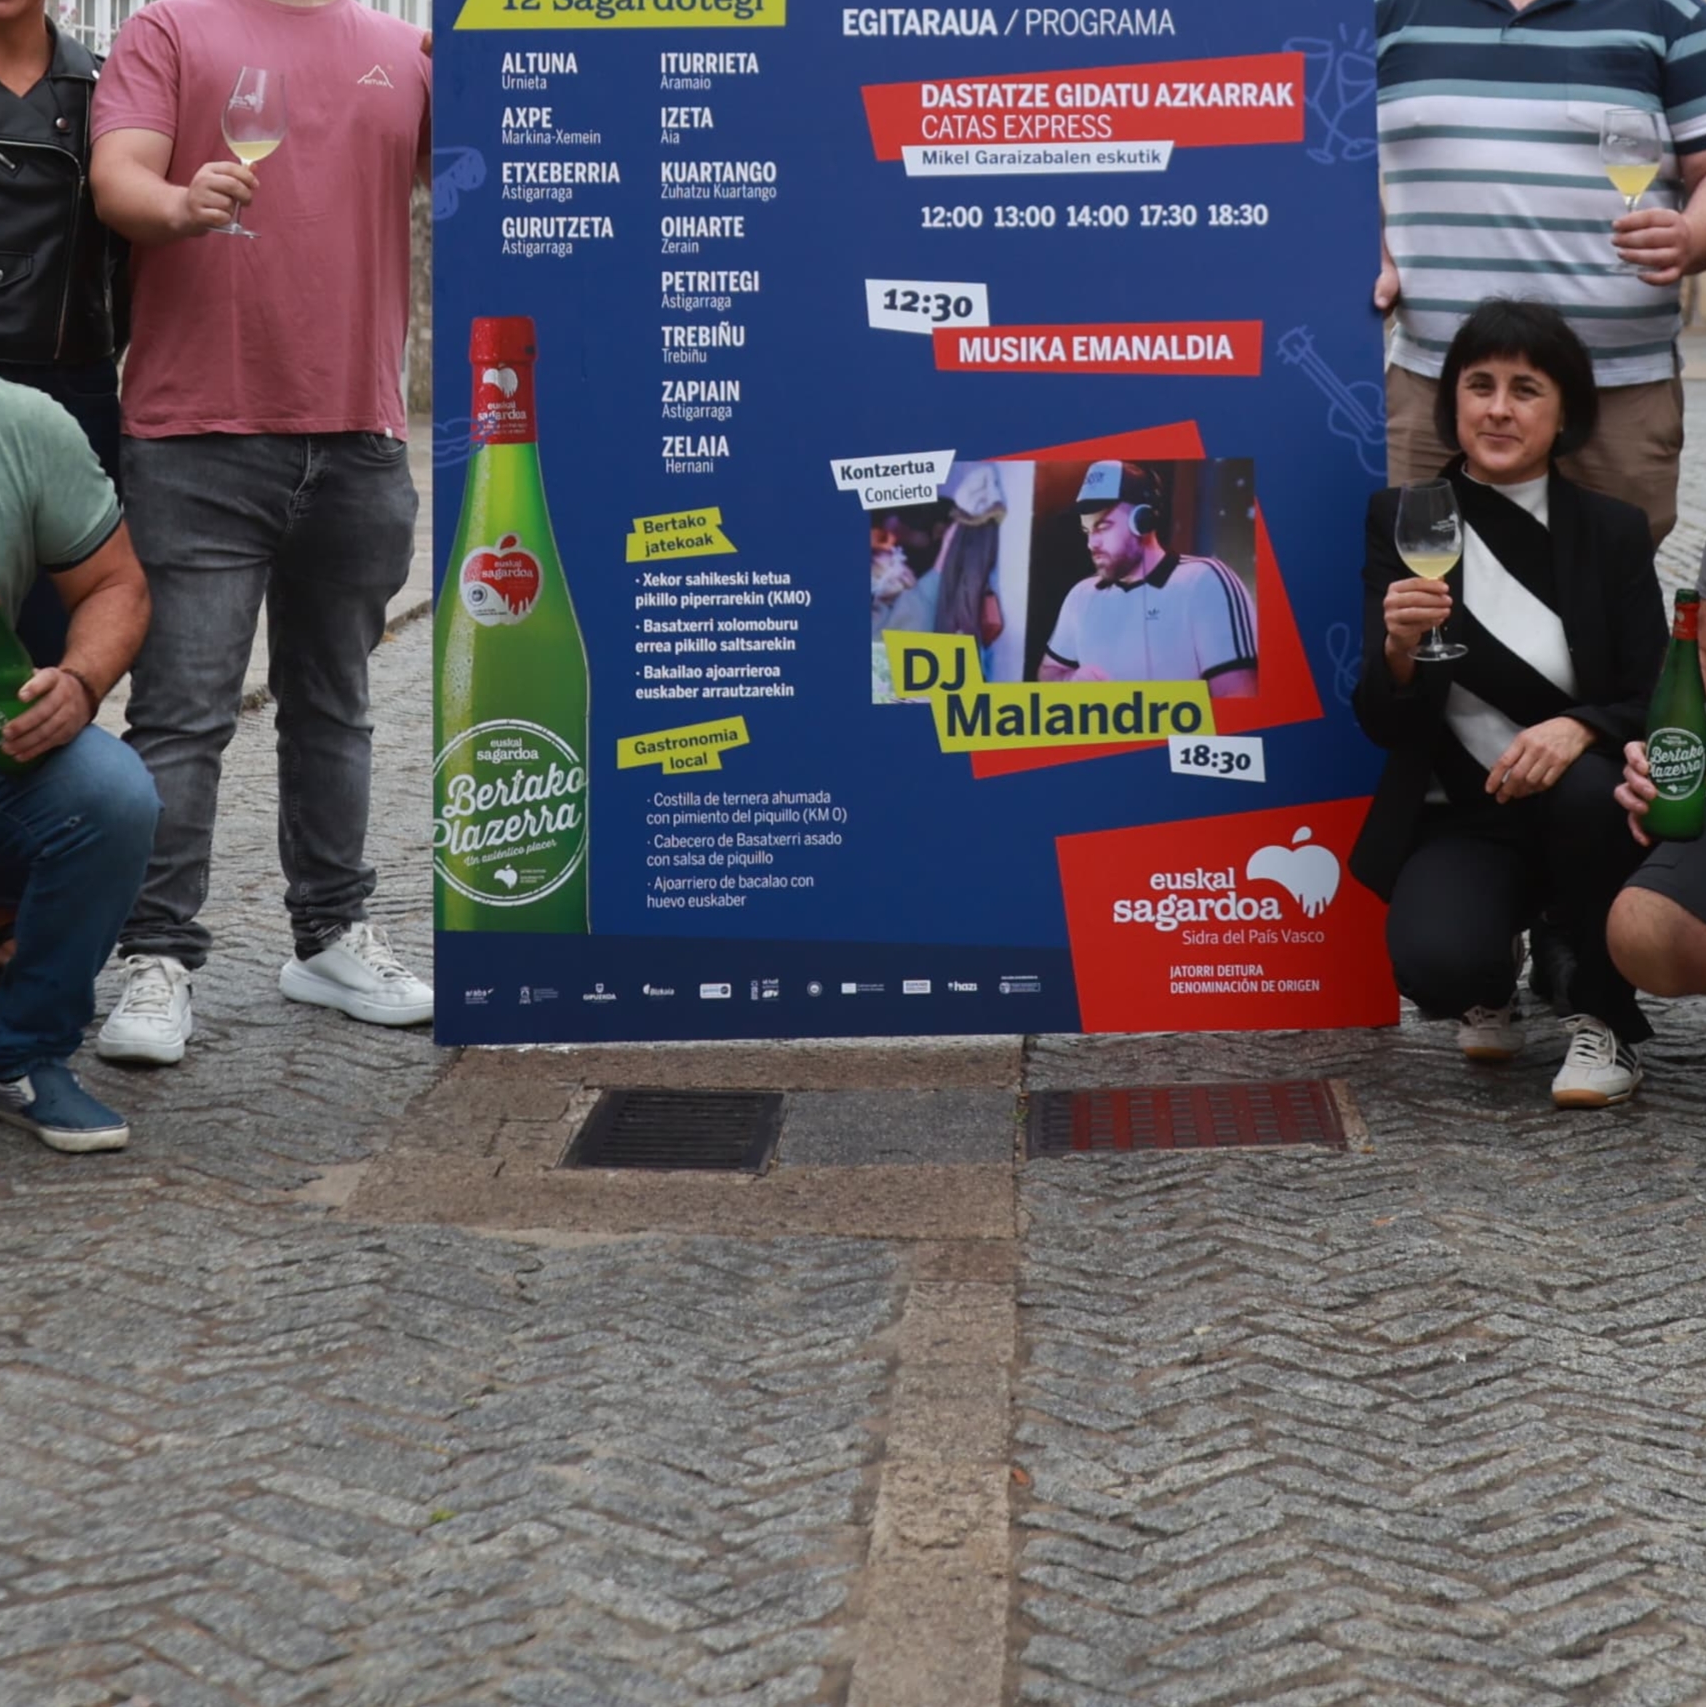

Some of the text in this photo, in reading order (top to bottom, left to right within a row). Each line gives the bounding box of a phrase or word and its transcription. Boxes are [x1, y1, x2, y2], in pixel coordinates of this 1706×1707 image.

[842, 8, 1176, 36] EGITARAUA / PROGRAMA
[501, 52, 578, 74] ALTUNA
[660, 52, 759, 74] ITURRIETA
[501, 74, 547, 90] Urnieta
[660, 75, 711, 90] Aramaio
[921, 81, 1294, 109] DASTATZE GIDATU AZKARRAK
[501, 106, 553, 128] AXPE
[660, 106, 714, 128] IZETA
[921, 113, 1113, 140] CATAS EXPRESS
[501, 129, 601, 145] Markina-Xemein
[660, 129, 680, 144] Aia
[921, 148, 1161, 166] Mikel Garaizabalen eskutik
[501, 161, 621, 183] ETXEBERRIA
[660, 161, 777, 183] KUARTANGO
[501, 184, 573, 203] Astigarraga
[660, 183, 777, 202] Zuhatzu Kuartango
[921, 203, 1269, 229] 12:00 13:00 14:00 17:30 18:30
[501, 216, 614, 239] GURUTZETA
[660, 216, 745, 238] OIHARTE
[501, 239, 573, 258] Astigarraga
[660, 238, 699, 254] Zerain
[661, 270, 760, 292] PETRITEGI
[661, 293, 732, 311] Astigarraga
[882, 288, 974, 323] 12:30
[661, 320, 746, 347] TREBIÑU
[661, 347, 707, 364] Trebiñu
[958, 333, 1234, 364] MUSIKA EMANALDIA
[661, 380, 741, 403] ZAPIAIN
[662, 402, 733, 422] Astigarraga
[662, 435, 730, 458] ZELAIA
[665, 458, 714, 474] Hernani
[840, 457, 936, 482] Kontzertua
[864, 483, 933, 504] Concierto
[642, 514, 707, 535] Bertako
[645, 532, 714, 558] jatekoak
[481, 566, 534, 581] sagardoa
[642, 571, 791, 587] Xekor sahikeski ketua
[635, 592, 678, 610] pikillo
[680, 591, 765, 609] piperrarekin
[643, 617, 799, 633] Basatxerri xolomoburu
[635, 637, 796, 655] errea pikillo saltsarekin
[643, 663, 781, 681] Bakailao ajoarrieroa
[902, 647, 966, 692] DJ
[635, 683, 795, 700] euskaber arrautzarekin
[946, 691, 1203, 737] Malandro
[489, 737, 523, 748] euskal
[634, 728, 739, 756] Gastronomia
[476, 747, 540, 764] sagardoa
[669, 751, 709, 770] local
[1179, 744, 1251, 774] 18:30
[1649, 744, 1705, 764] Bertako
[1648, 759, 1701, 778] lazerra
[441, 762, 587, 819] Bertako
[653, 790, 831, 807] Costilla de ternera ahumada
[646, 812, 671, 825] con
[672, 810, 730, 828] pimiento
[731, 809, 752, 824] del
[754, 808, 800, 826] piquillo
[802, 807, 830, 824] (KM
[653, 831, 842, 849] Cabecero de Basatxerri asado
[646, 850, 774, 868] con salsa de piquillo
[653, 874, 814, 893] Ajoarriero de bacalao con
[1149, 866, 1236, 892] euskal
[646, 893, 747, 909] huevo euskaber
[1113, 891, 1283, 932] sagardoa
[1182, 928, 1325, 945] Sidra del País Vasco
[1169, 964, 1264, 980] JATORRI DEITURA
[1169, 979, 1321, 994] DENOMINACIÓN DE ORIGEN
